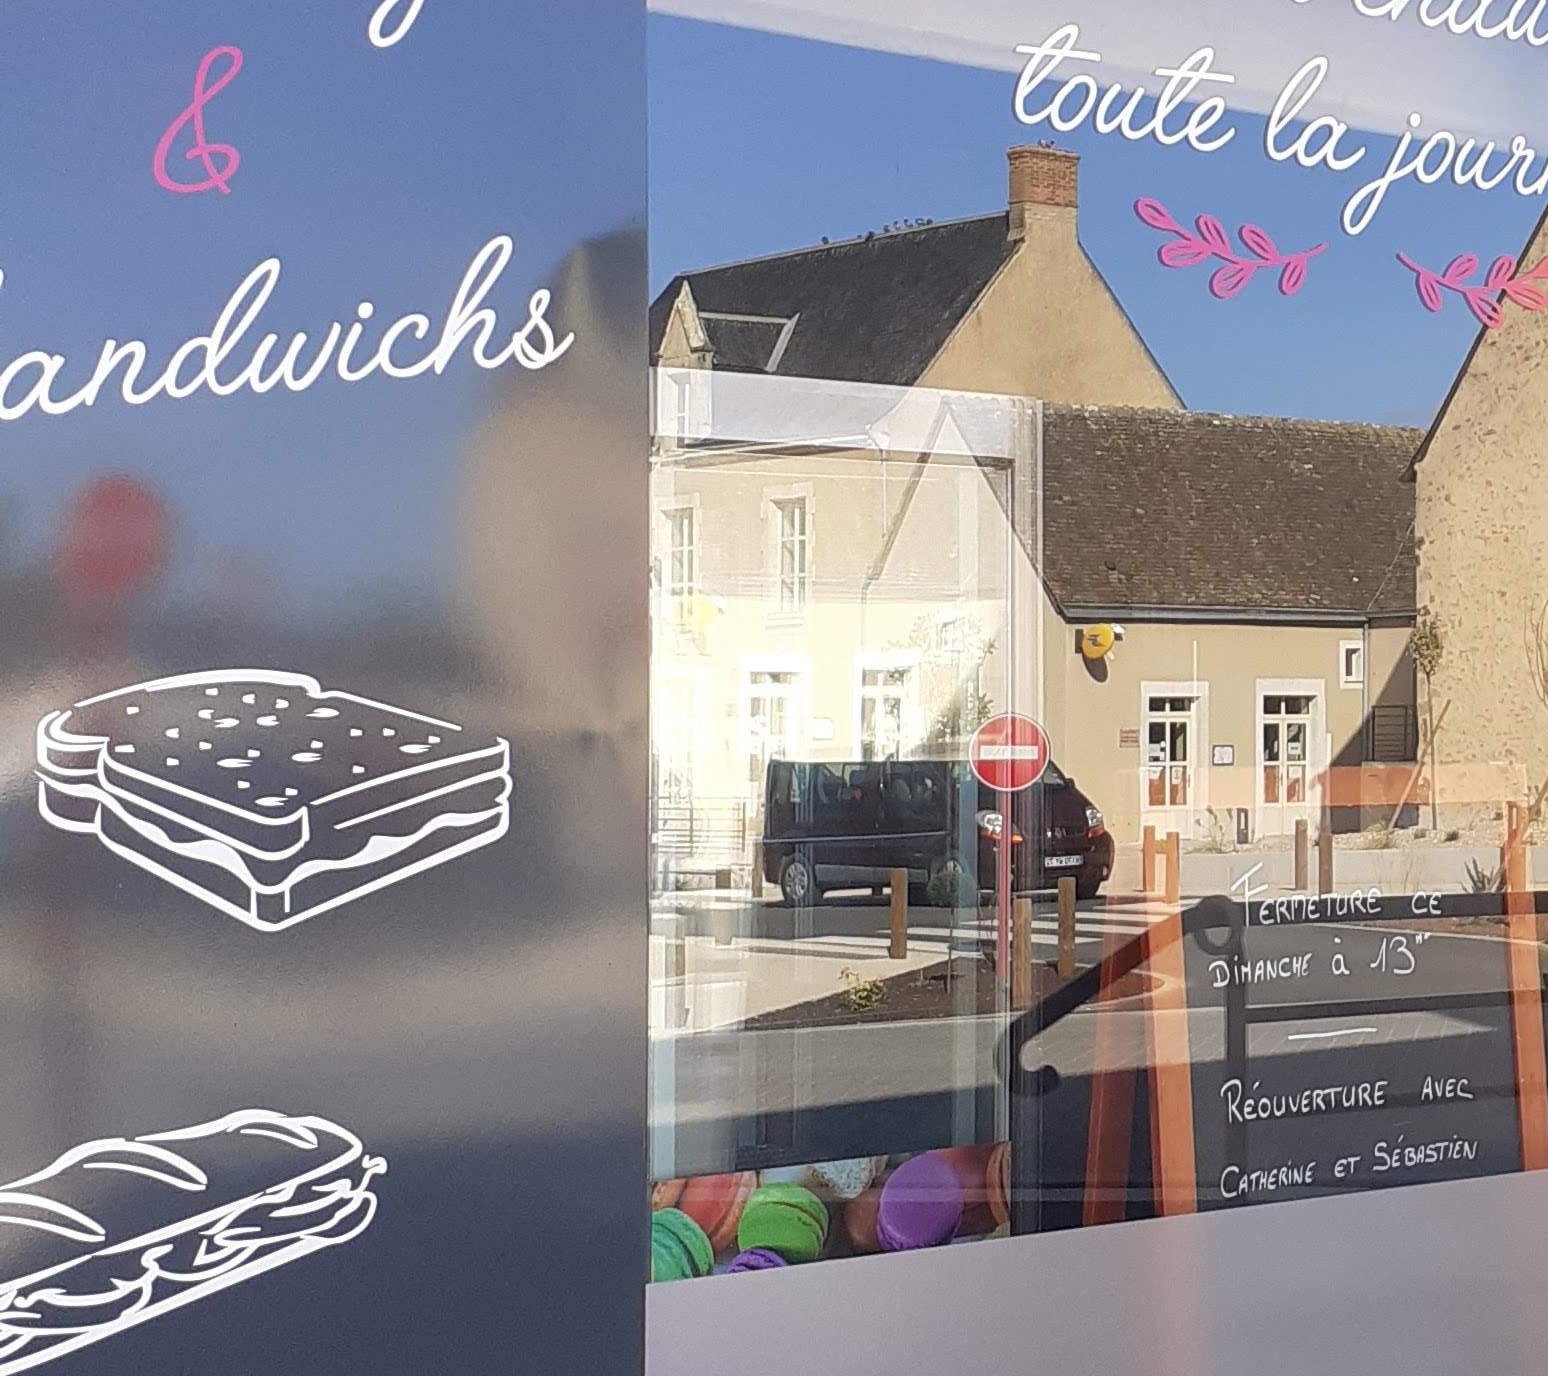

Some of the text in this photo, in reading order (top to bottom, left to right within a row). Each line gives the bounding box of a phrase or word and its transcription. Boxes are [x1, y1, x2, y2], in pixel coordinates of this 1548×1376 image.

[152, 45, 244, 196] &
[1012, 24, 1236, 152] toute
[1266, 56, 1366, 169] la
[0, 235, 575, 421] andwichs
[1231, 862, 1442, 928] FERMETURE CE
[1332, 937, 1350, 975] à
[1420, 1075, 1474, 1101] AVEC
[1220, 1134, 1478, 1198] CATHERINE ET SÉBASTIEN
